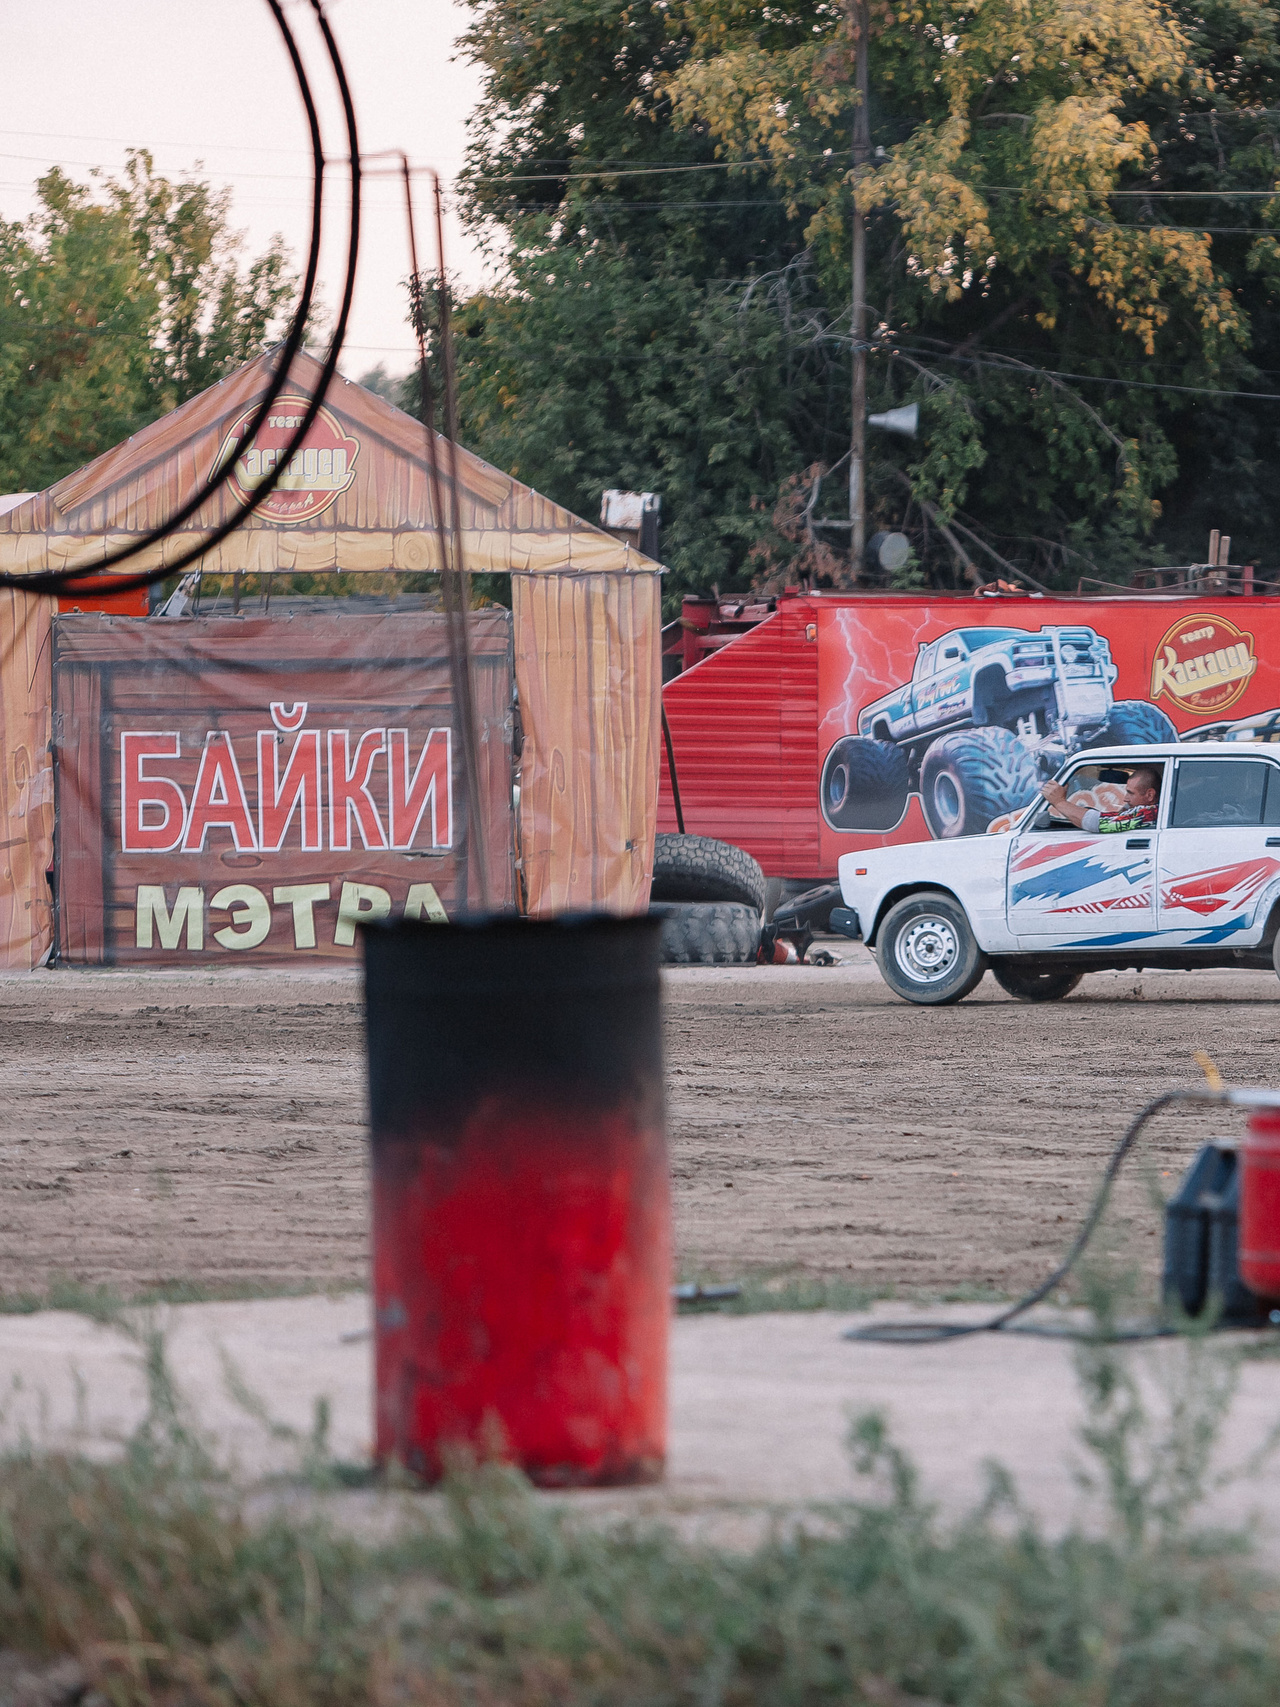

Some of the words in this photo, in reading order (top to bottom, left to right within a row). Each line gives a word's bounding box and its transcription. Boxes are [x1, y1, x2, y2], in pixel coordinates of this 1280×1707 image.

[267, 415, 313, 428] теат
[1153, 642, 1254, 698] Каскадер
[121, 701, 453, 853] БАЙКИ
